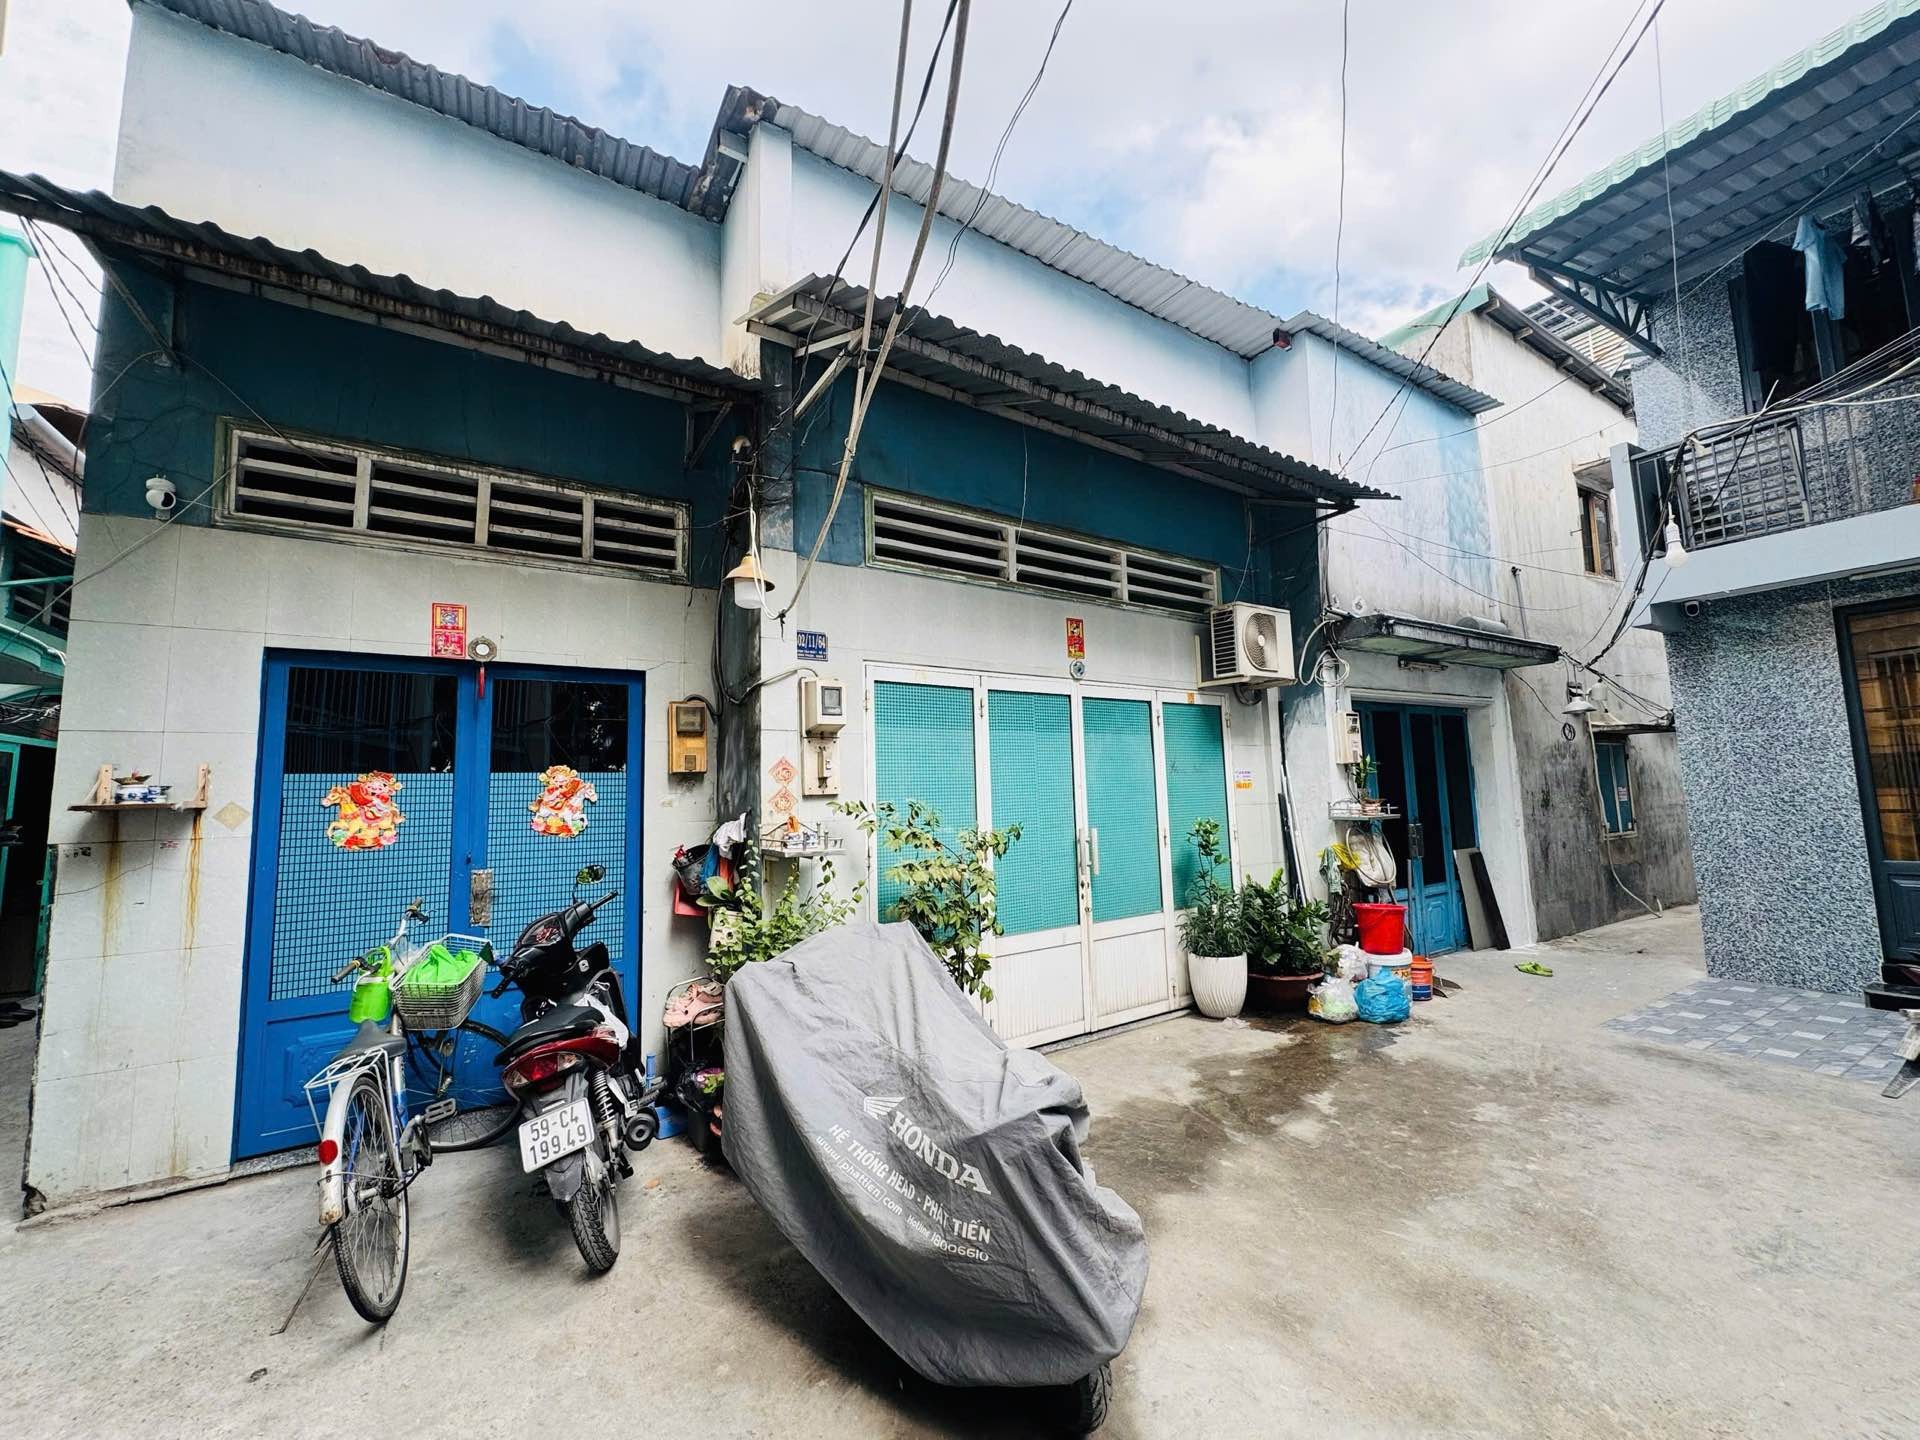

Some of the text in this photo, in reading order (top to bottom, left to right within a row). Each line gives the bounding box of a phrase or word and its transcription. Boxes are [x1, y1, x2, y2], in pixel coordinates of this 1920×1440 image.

[529, 1124, 587, 1166] 199.49
[530, 1106, 579, 1142] 59-C4
[889, 1110, 992, 1195] HONDA
[815, 1135, 903, 1216] www phattien com
[828, 1124, 850, 1145] HỆ
[847, 1139, 889, 1179] THỐNG
[887, 1170, 916, 1199] HEAD
[922, 1194, 949, 1229] PHÁT
[952, 1218, 991, 1245] TIẾN
[906, 1213, 990, 1262] Hotline 18006610
